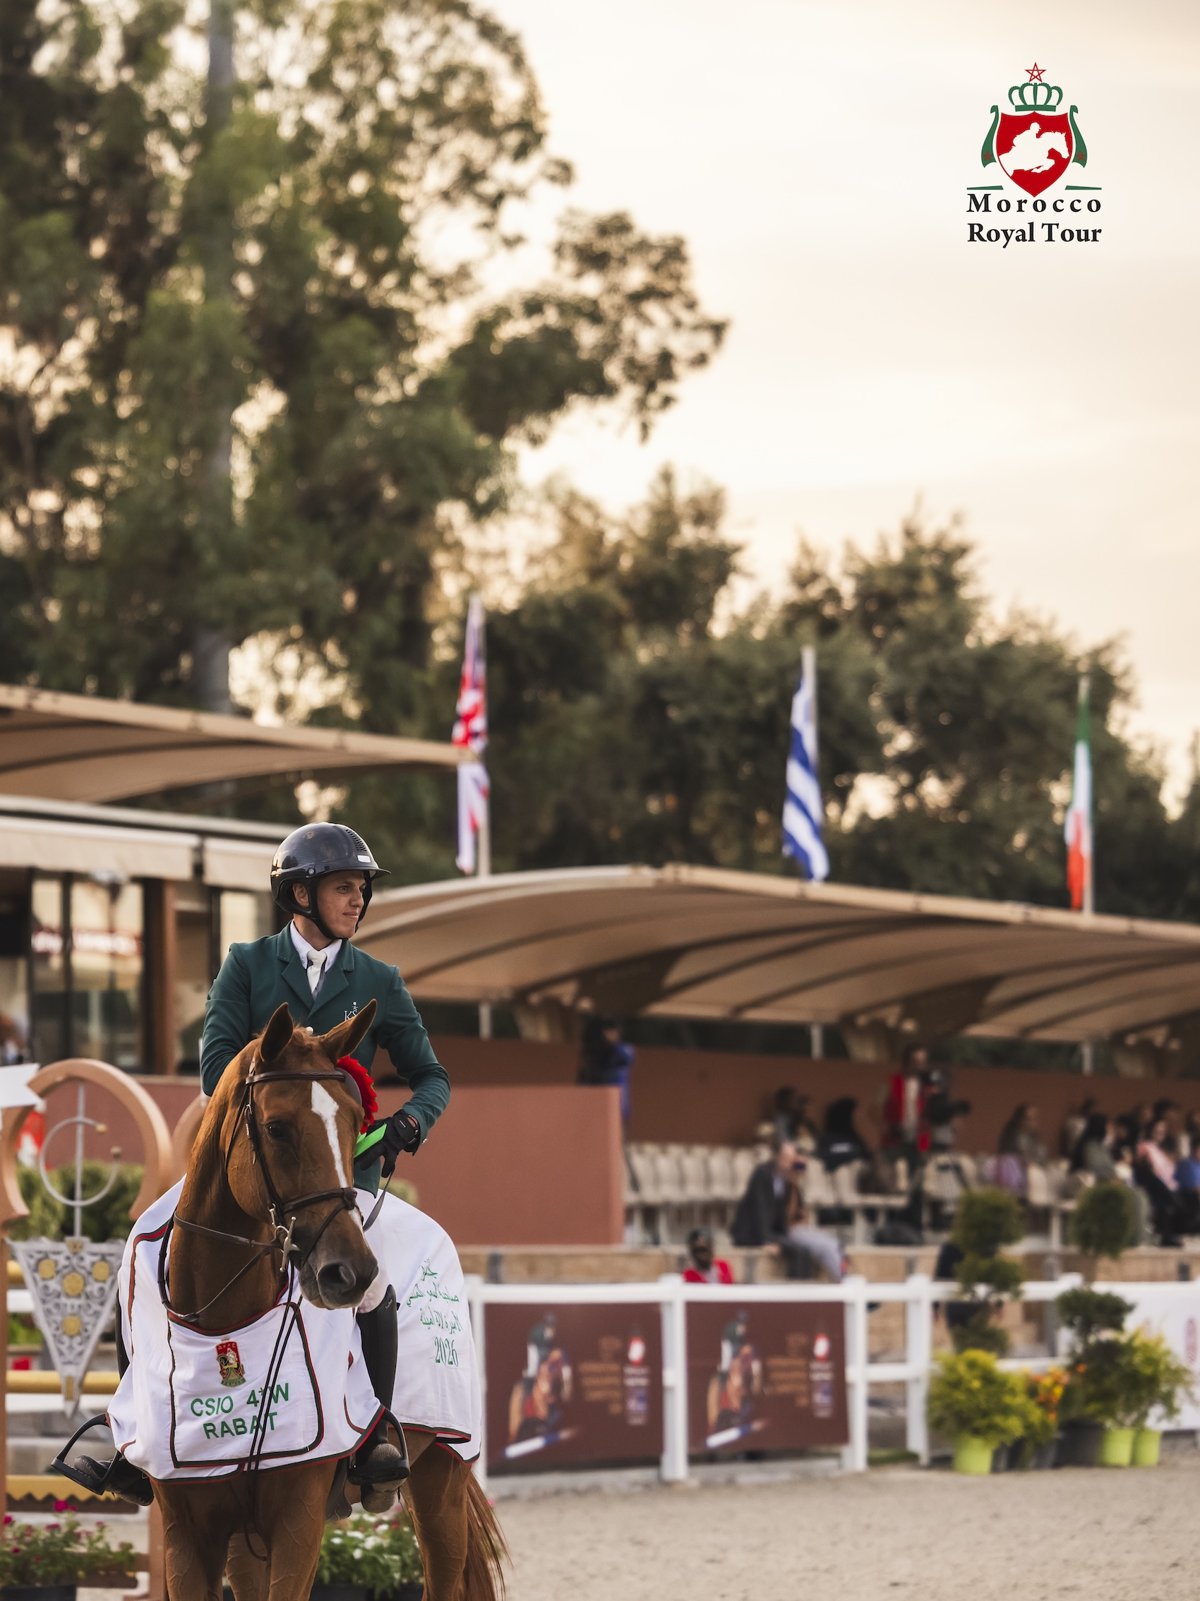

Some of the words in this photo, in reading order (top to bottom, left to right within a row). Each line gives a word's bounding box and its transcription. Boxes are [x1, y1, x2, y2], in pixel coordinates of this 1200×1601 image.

[434, 1336, 459, 1368] 2026
[190, 1395, 234, 1417] CSIO
[202, 1411, 278, 1440] RABAT
